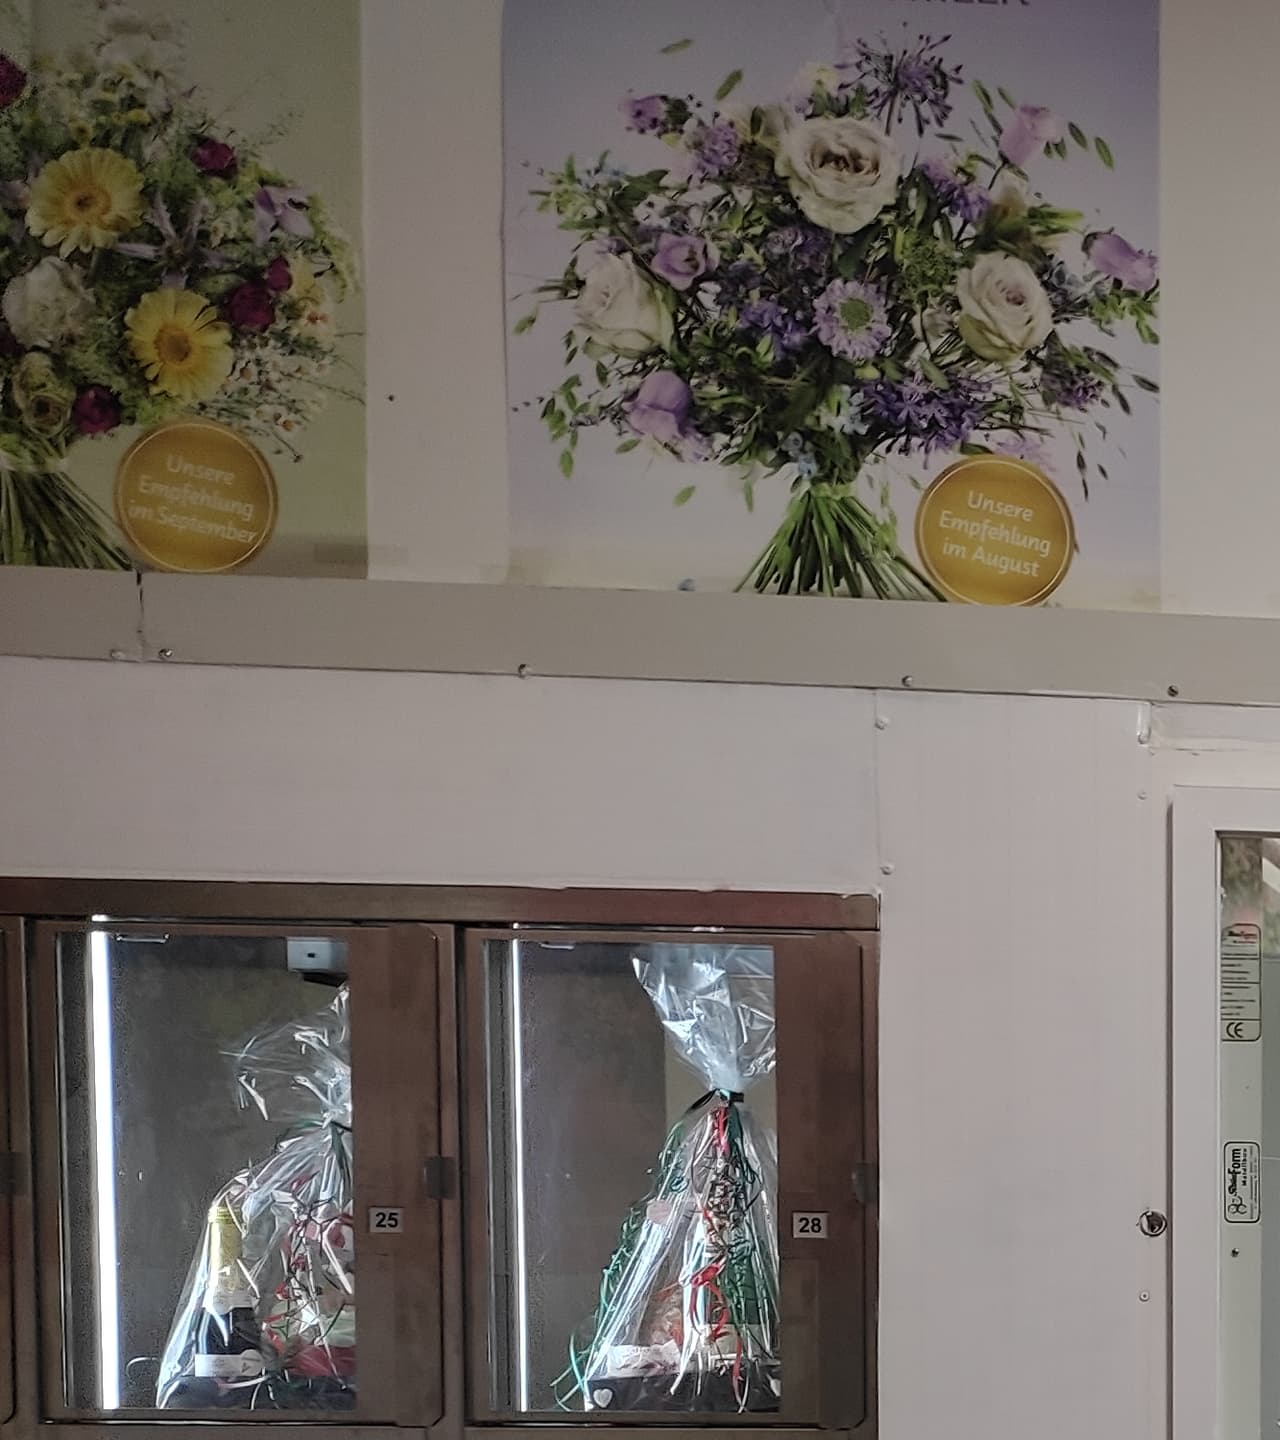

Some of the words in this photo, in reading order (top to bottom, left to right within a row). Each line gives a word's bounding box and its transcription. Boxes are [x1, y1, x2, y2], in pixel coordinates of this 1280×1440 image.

[166, 454, 235, 485] Unsere
[138, 474, 255, 522] Empfehlung
[967, 490, 1033, 522] Unsere
[158, 505, 258, 543] September
[939, 510, 1051, 558] Empfehlung
[943, 537, 966, 558] im
[972, 546, 1040, 577] August
[376, 1212, 398, 1228] 25
[799, 1217, 821, 1233] 28
